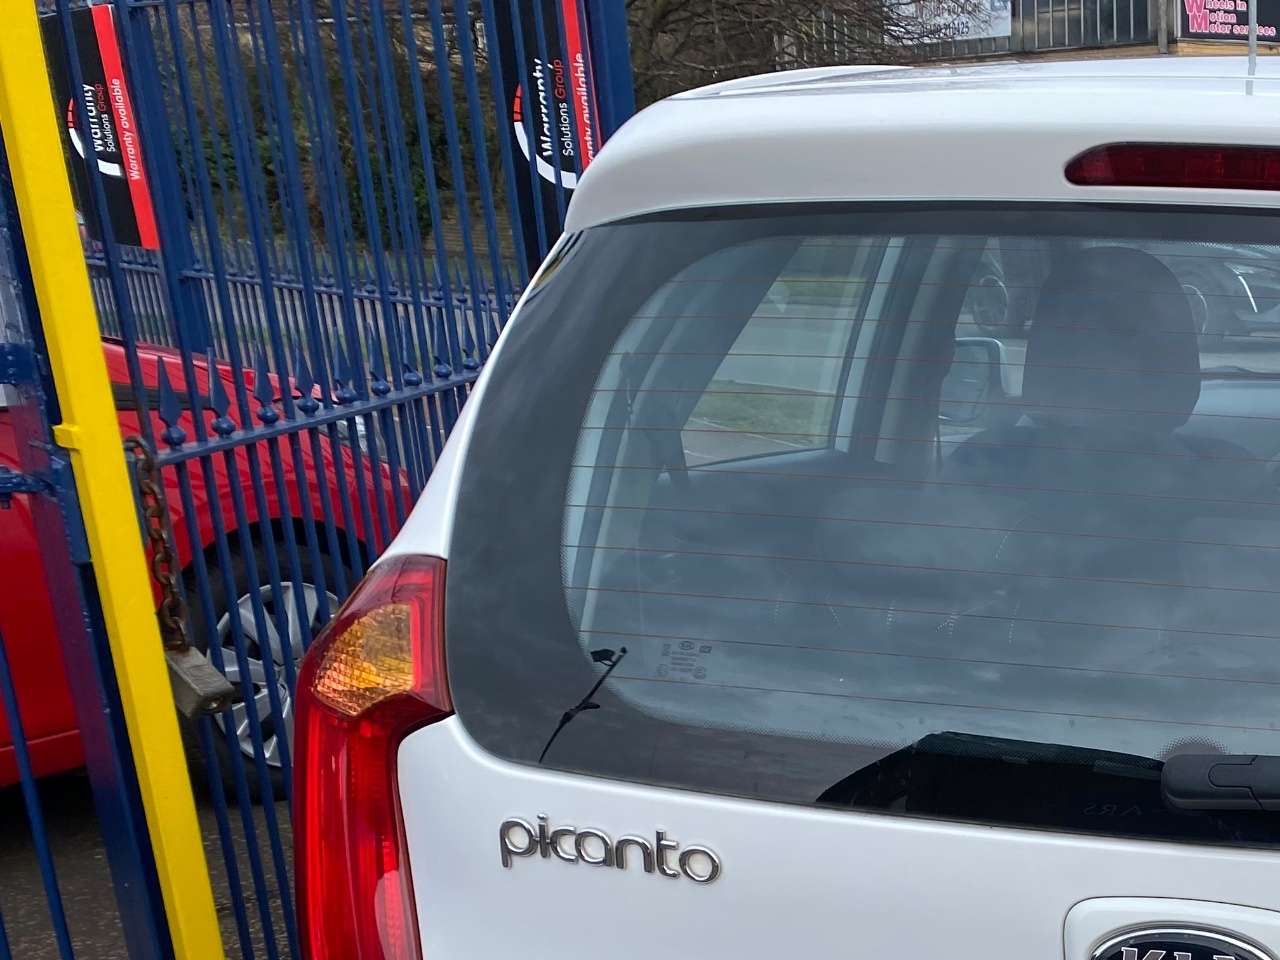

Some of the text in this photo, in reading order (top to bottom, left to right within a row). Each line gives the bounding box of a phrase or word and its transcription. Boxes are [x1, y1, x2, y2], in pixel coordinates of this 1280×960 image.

[1236, 0, 1247, 11] in
[94, 83, 116, 152] Solutions Group
[111, 78, 141, 180] Warranty available
[553, 59, 575, 156] Solutions Group
[499, 812, 722, 884] picanto
